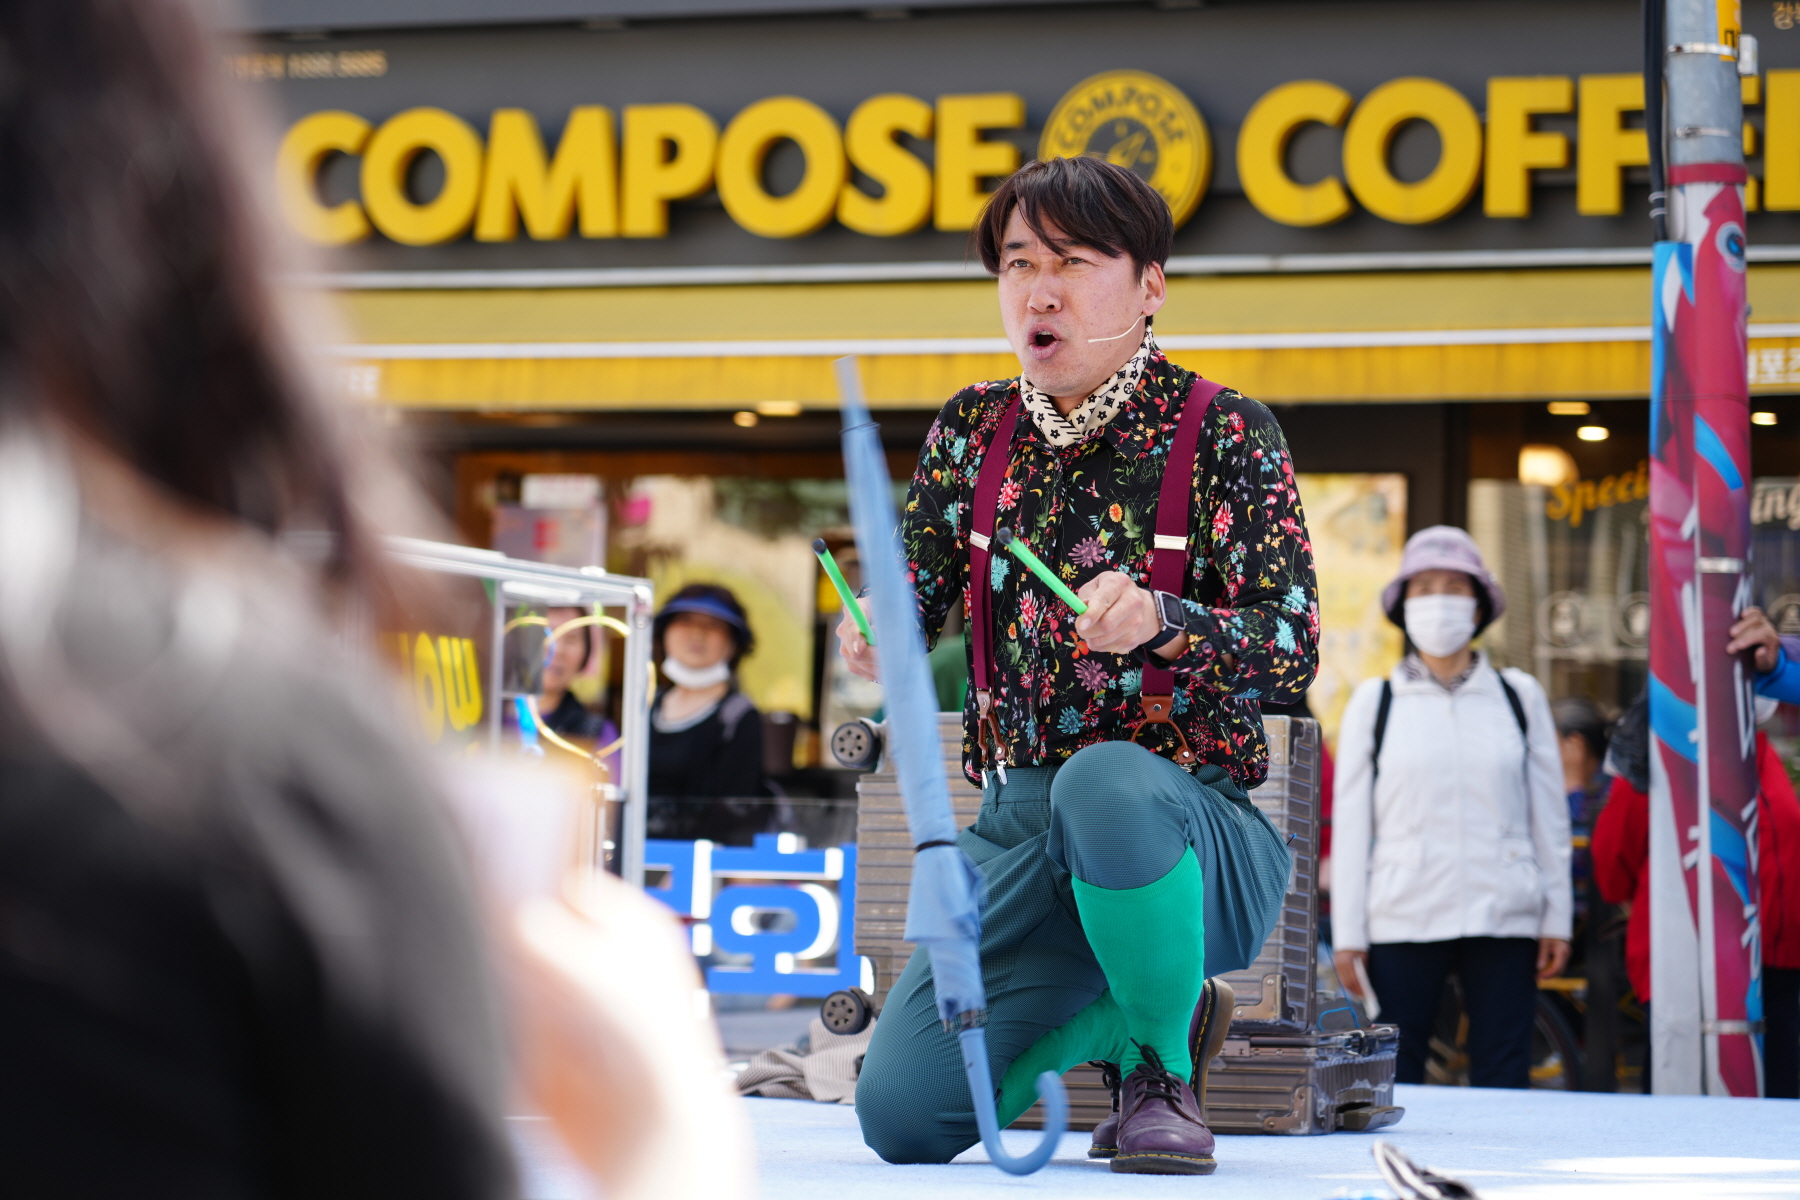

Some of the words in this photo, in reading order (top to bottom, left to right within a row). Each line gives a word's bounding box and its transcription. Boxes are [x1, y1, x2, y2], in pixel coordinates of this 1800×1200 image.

[276, 92, 1024, 246] COMPOSE
[1057, 86, 1185, 150] COMPOSE
[1236, 68, 1800, 227] COFF
[1545, 459, 1650, 528] Speci
